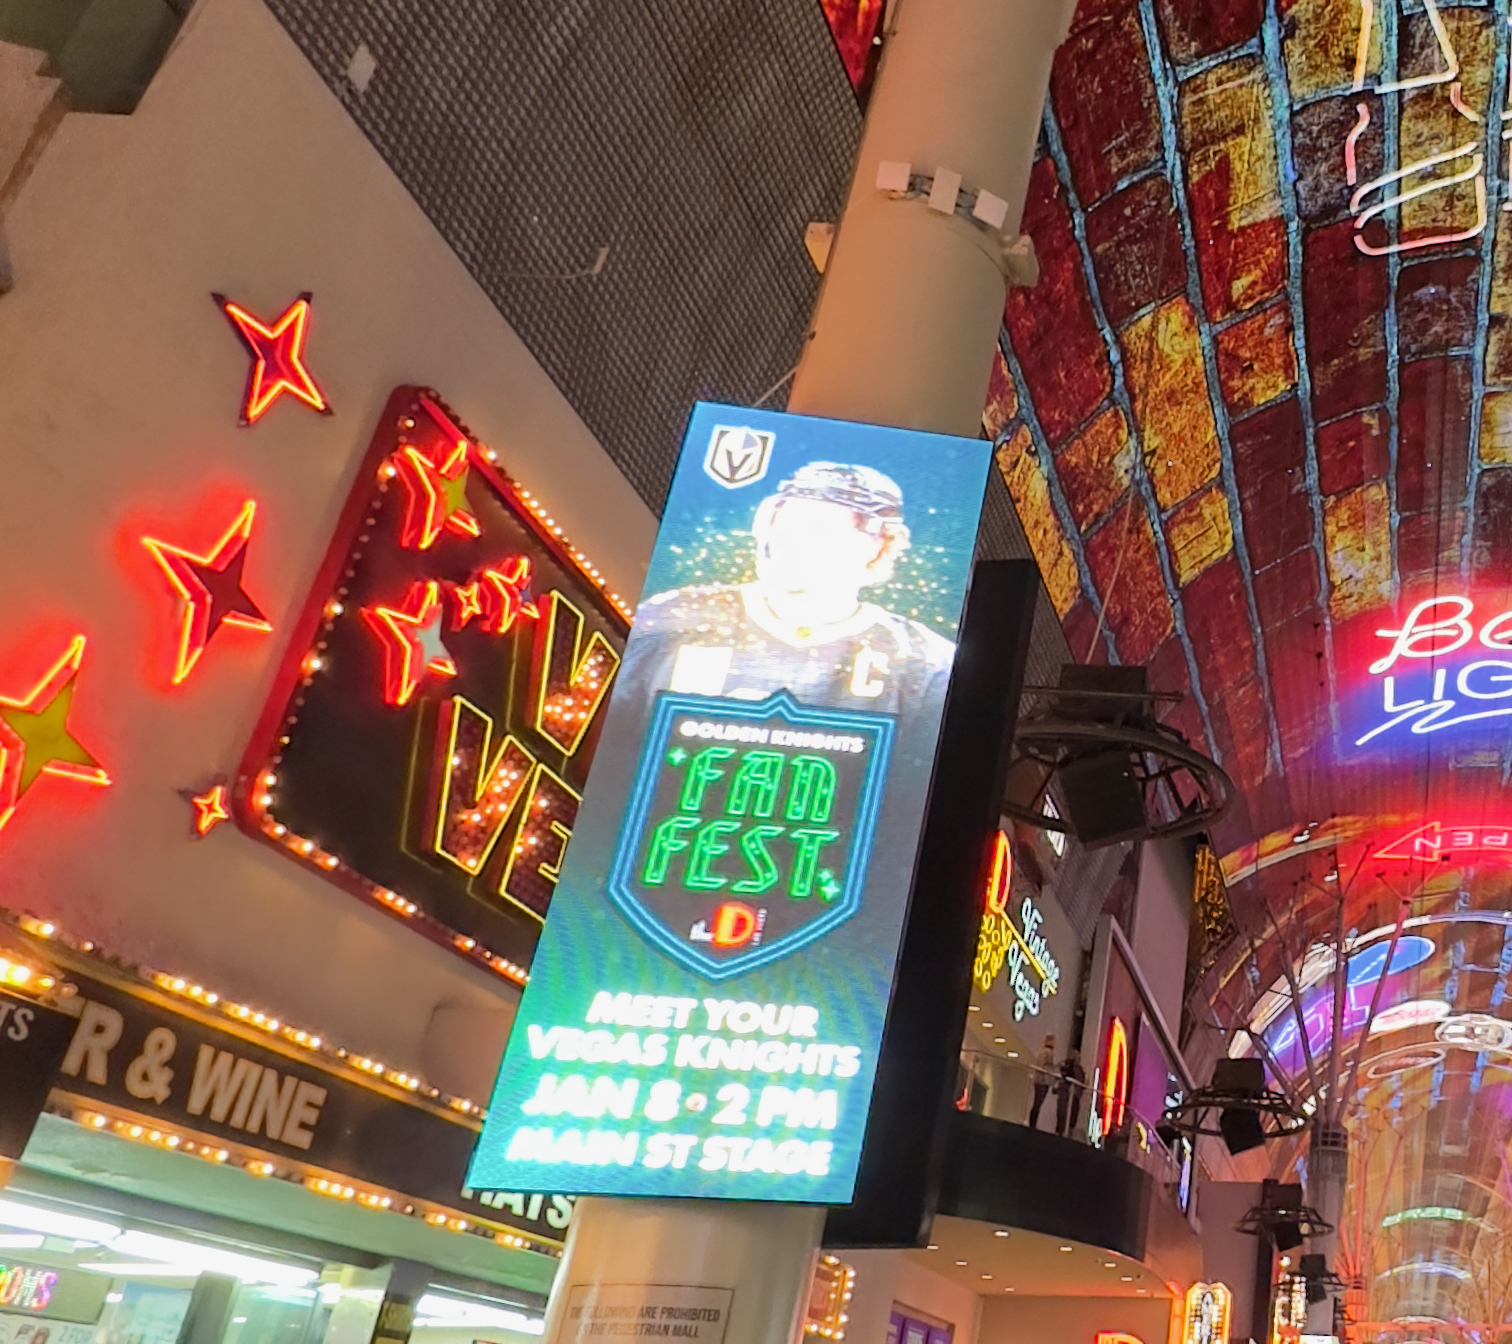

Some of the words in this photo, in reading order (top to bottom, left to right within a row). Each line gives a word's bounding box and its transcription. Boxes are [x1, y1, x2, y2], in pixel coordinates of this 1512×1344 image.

[679, 720, 769, 744] GOLDEN
[770, 728, 867, 754] KNIGHTS
[679, 746, 838, 824] FAN
[642, 815, 842, 898] FEST
[586, 991, 698, 1029] MEET
[702, 998, 820, 1038] YOUR
[527, 1024, 671, 1067] VEGAS
[673, 1034, 862, 1078] KNIGHTS
[125, 1026, 178, 1105] &
[187, 1042, 328, 1151] WINE
[520, 1072, 640, 1120] JAN
[644, 1079, 682, 1122] 8
[711, 1082, 751, 1126] 2
[756, 1085, 839, 1130] PM
[505, 1125, 640, 1166] MAIN
[642, 1132, 698, 1169] ST
[697, 1135, 835, 1176] STAGE
[606, 1322, 670, 1337] PEDESTRIAN
[671, 1324, 700, 1338] MALL
[637, 1306, 657, 1320] ARE
[659, 1306, 721, 1323] PROHIBITED
